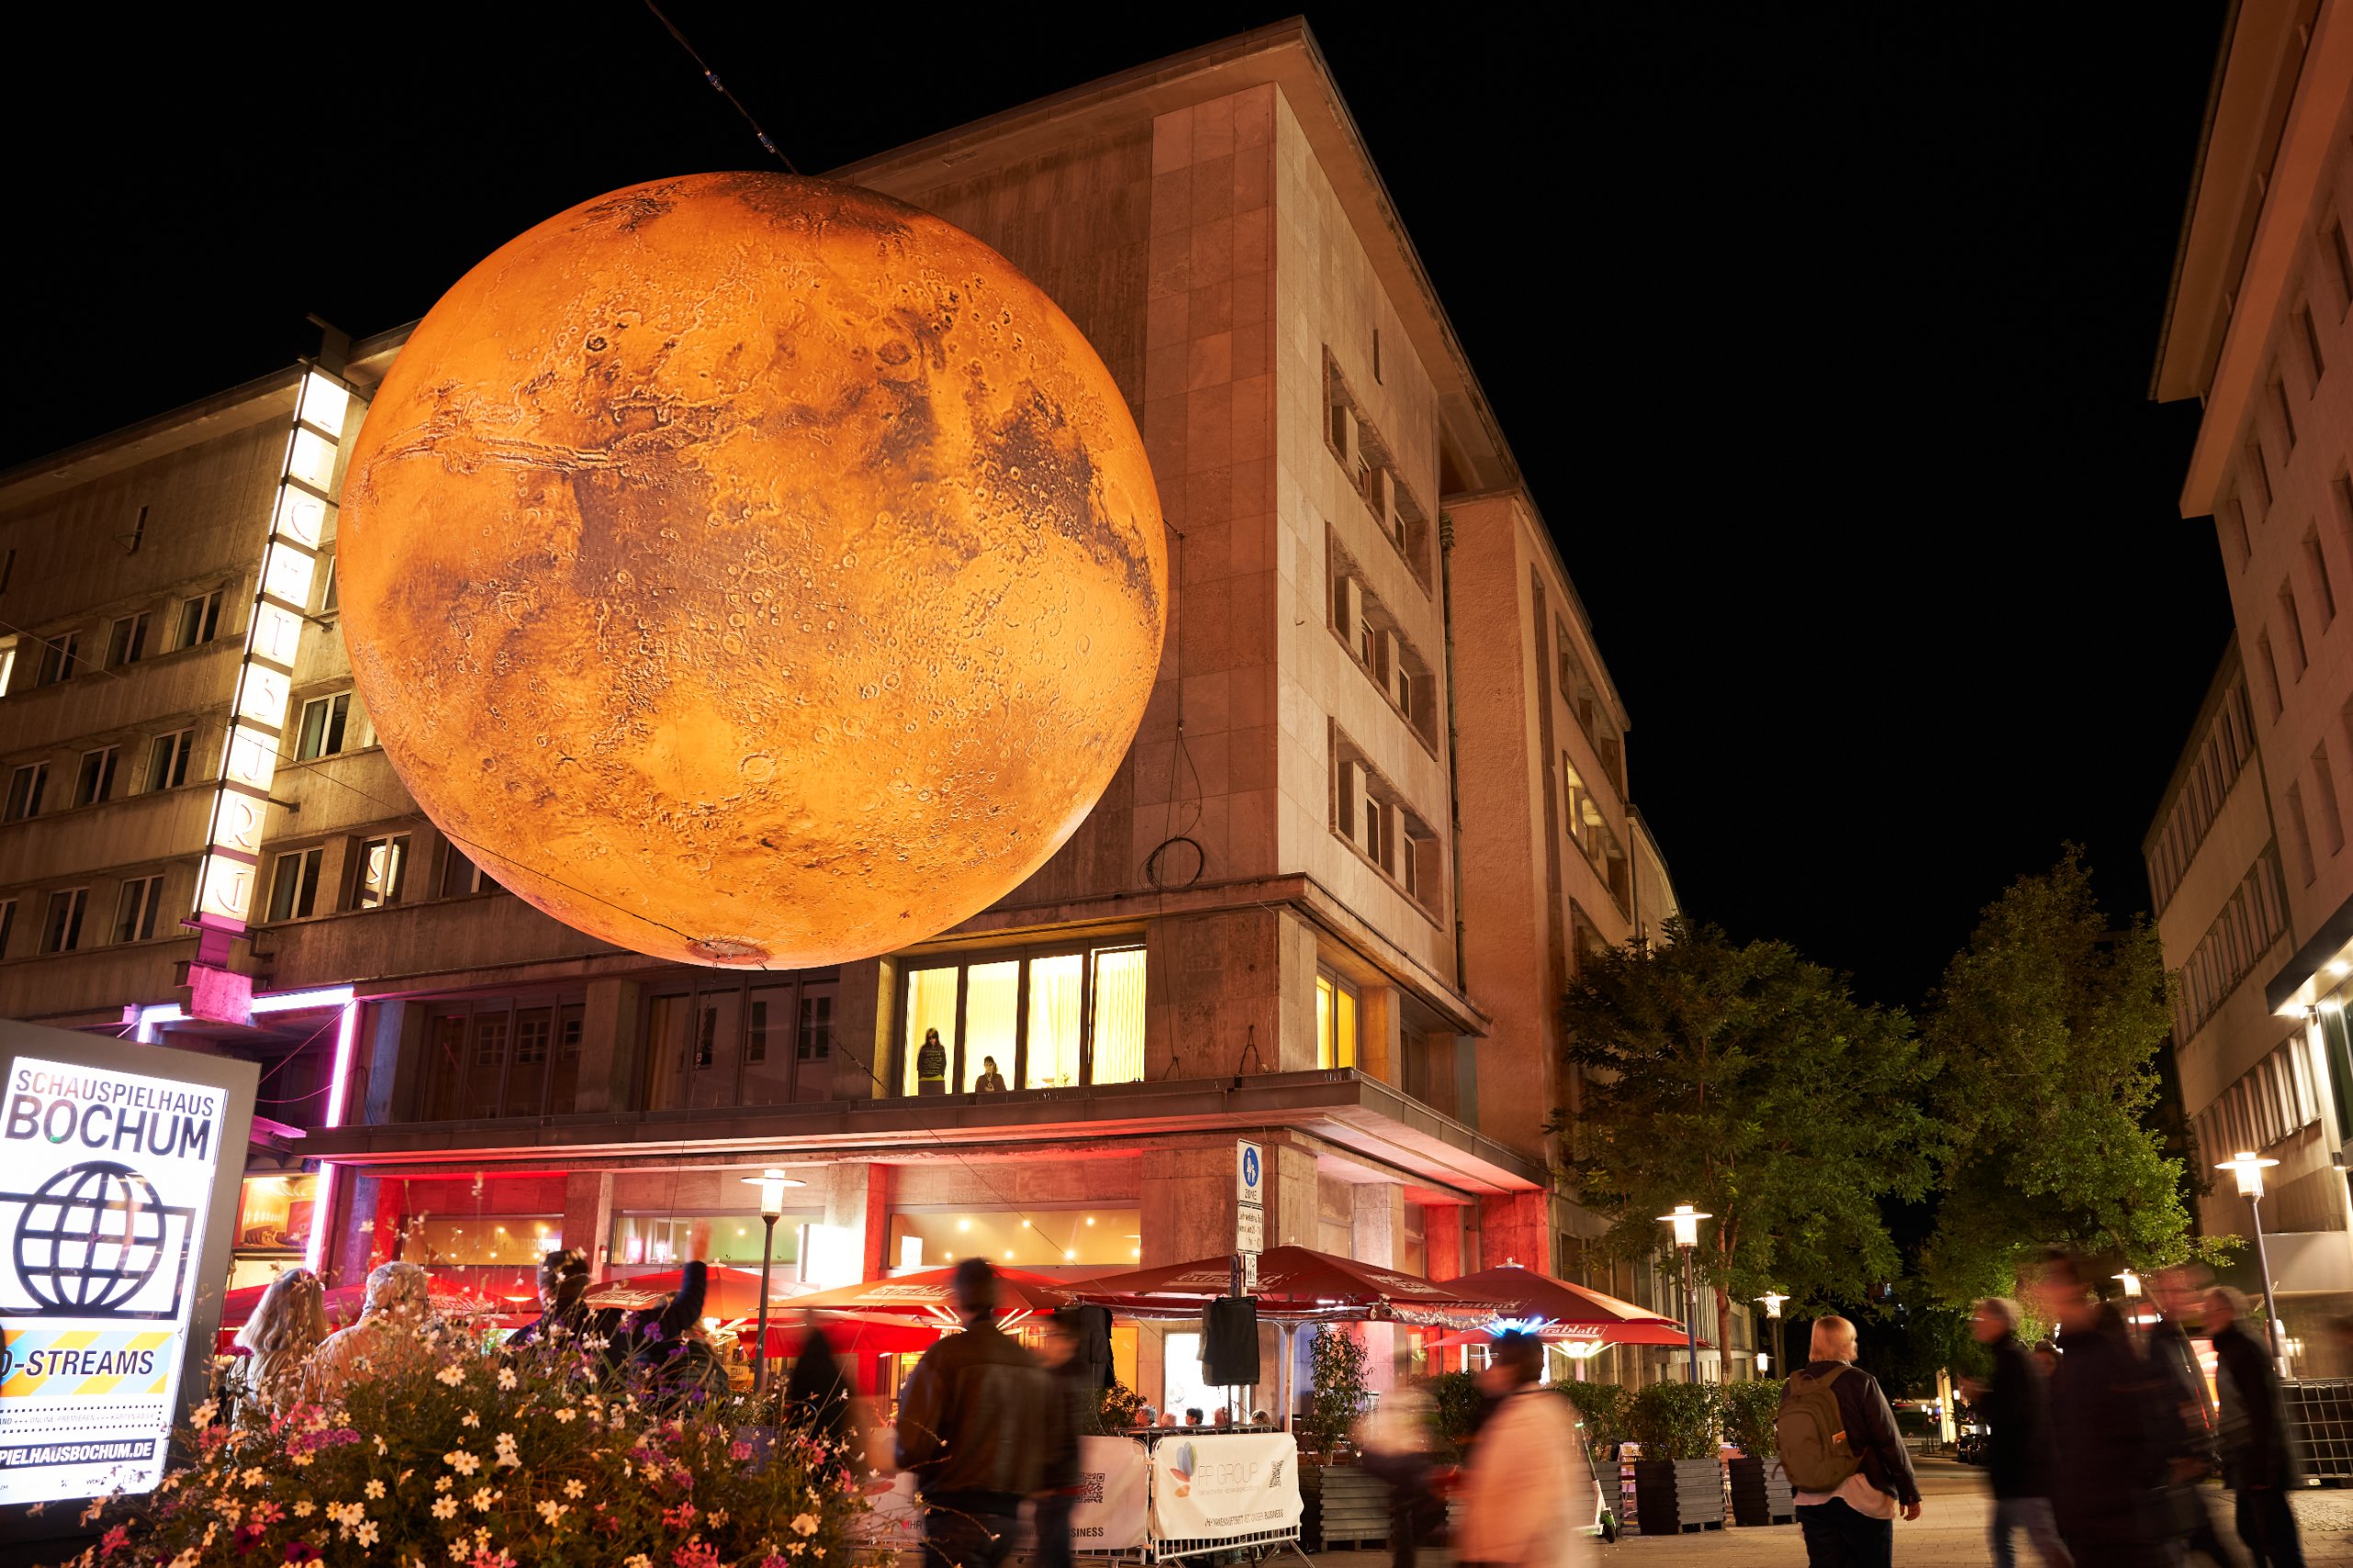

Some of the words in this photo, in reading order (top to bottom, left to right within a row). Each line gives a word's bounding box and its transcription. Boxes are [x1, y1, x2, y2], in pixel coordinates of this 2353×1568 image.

[16, 1069, 214, 1118] SCHAUSPIELHAUS
[5, 1094, 212, 1161] BOCHUM
[908, 1519, 923, 1530] IHR
